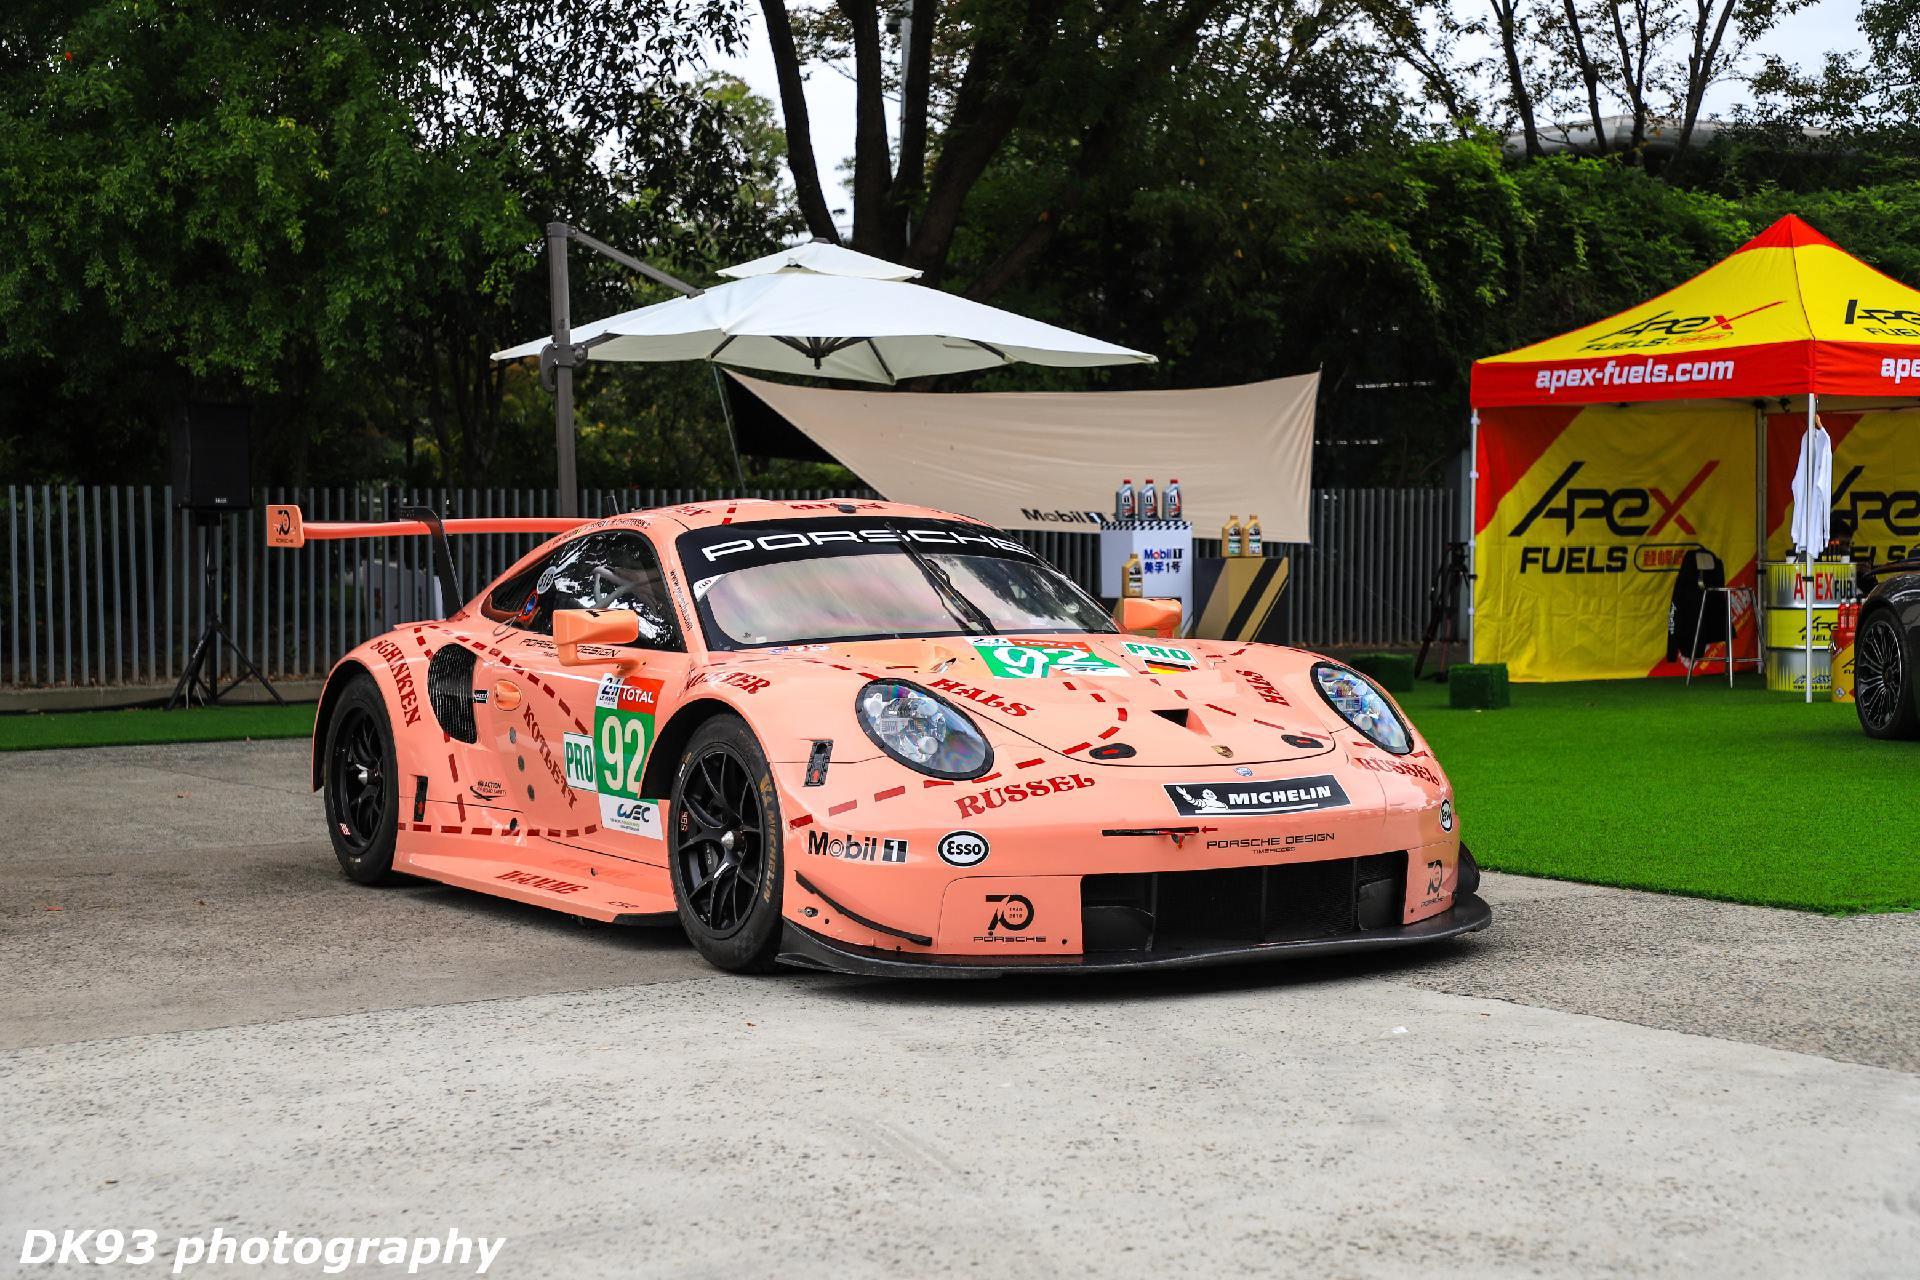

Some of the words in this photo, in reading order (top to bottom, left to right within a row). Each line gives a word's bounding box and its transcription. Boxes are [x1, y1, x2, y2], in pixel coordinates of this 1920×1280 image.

[1536, 358, 1734, 395] apex-fuels.com
[1021, 507, 1087, 523] Mobil
[702, 529, 1036, 562] PORSCHE
[1144, 548, 1172, 559] Mobil
[1520, 546, 1628, 574] FUELS
[1794, 572, 1834, 600] AEX
[520, 638, 558, 649] PORSC
[1125, 643, 1192, 661] PRO
[993, 647, 1104, 679] 92
[370, 639, 421, 728] SCHINKEN
[622, 686, 655, 703] TOTAL
[927, 678, 1036, 717] HALS
[565, 742, 594, 782] PRO
[602, 715, 646, 795] 92
[953, 772, 1095, 819] RÜSSEL
[1228, 786, 1332, 805] MICHELIN
[617, 804, 650, 822] WEC
[808, 830, 877, 861] Mobil
[885, 840, 904, 862] 1
[946, 840, 982, 857] Esso
[1207, 837, 1281, 850] PORSCHE
[1285, 833, 1335, 845] DESIGN
[985, 894, 1034, 931] 70
